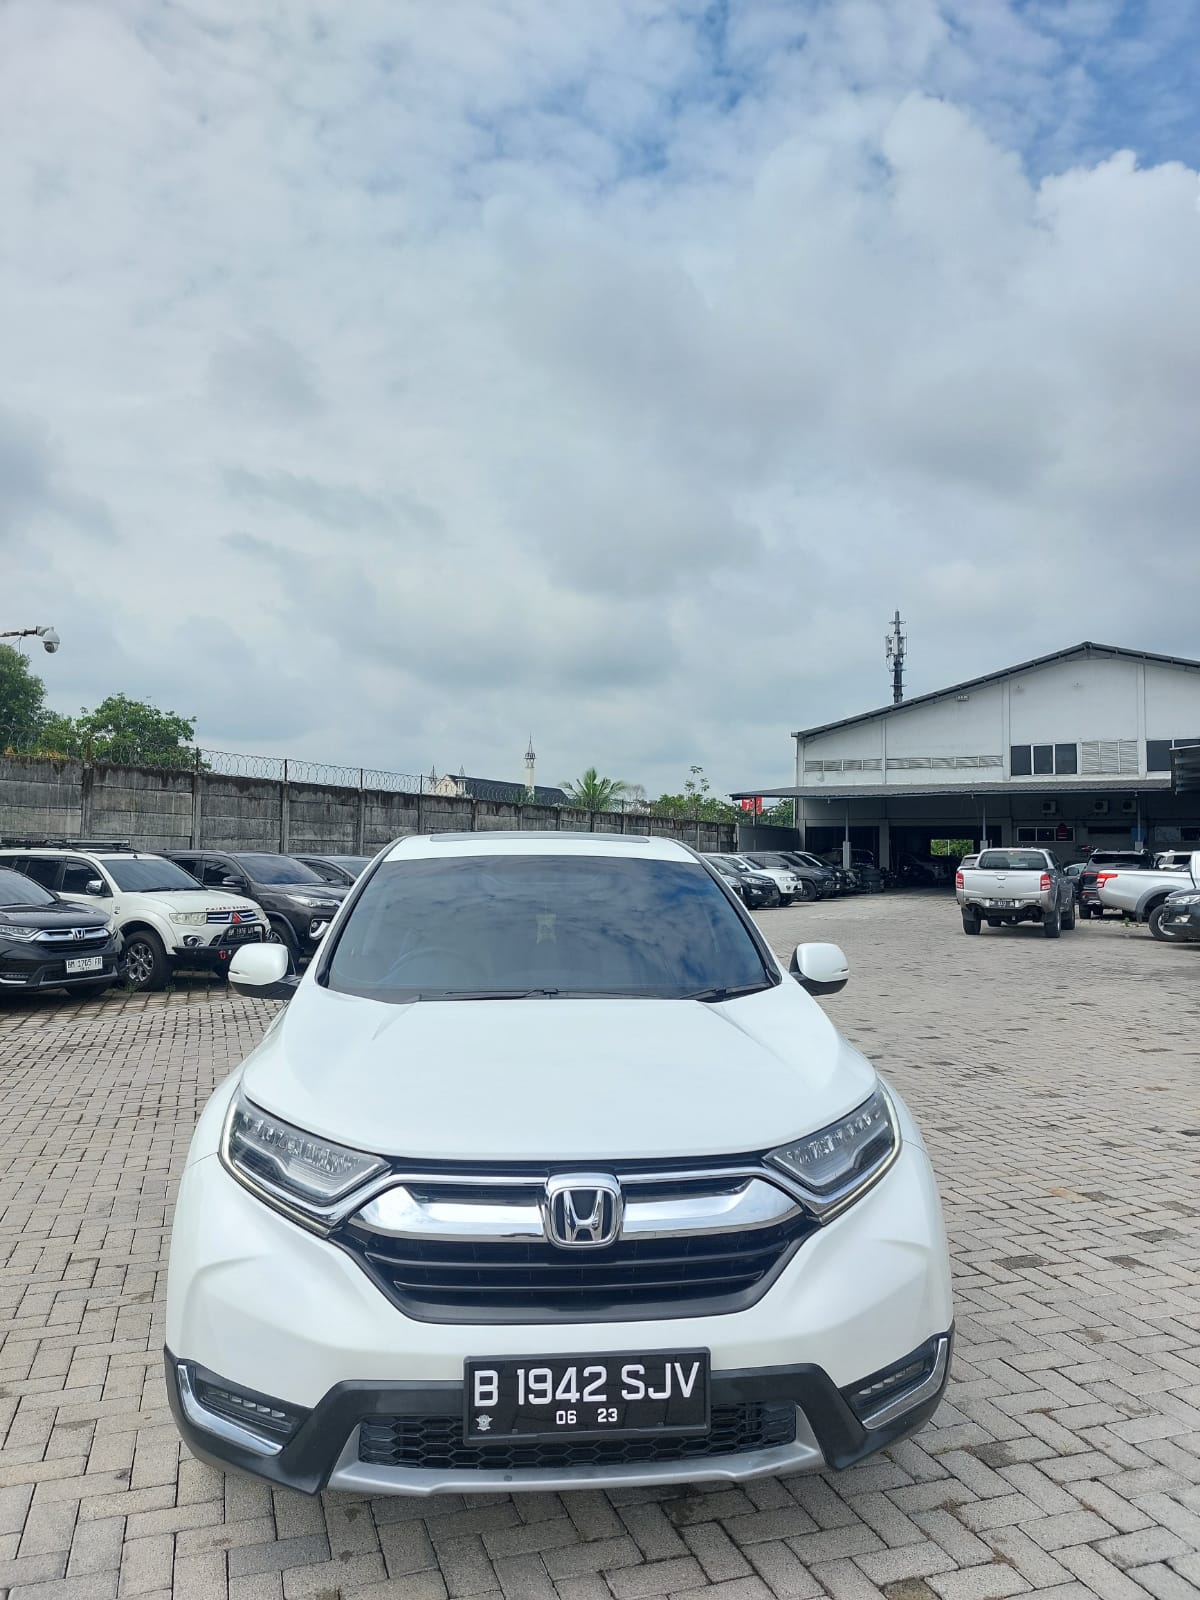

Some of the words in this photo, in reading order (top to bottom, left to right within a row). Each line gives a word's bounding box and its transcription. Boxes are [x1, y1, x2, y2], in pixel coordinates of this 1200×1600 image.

[474, 1370, 499, 1407] B
[516, 1365, 608, 1406] 1942
[621, 1362, 700, 1400] SJV
[556, 1410, 577, 1425] 06
[597, 1408, 618, 1423] 23
